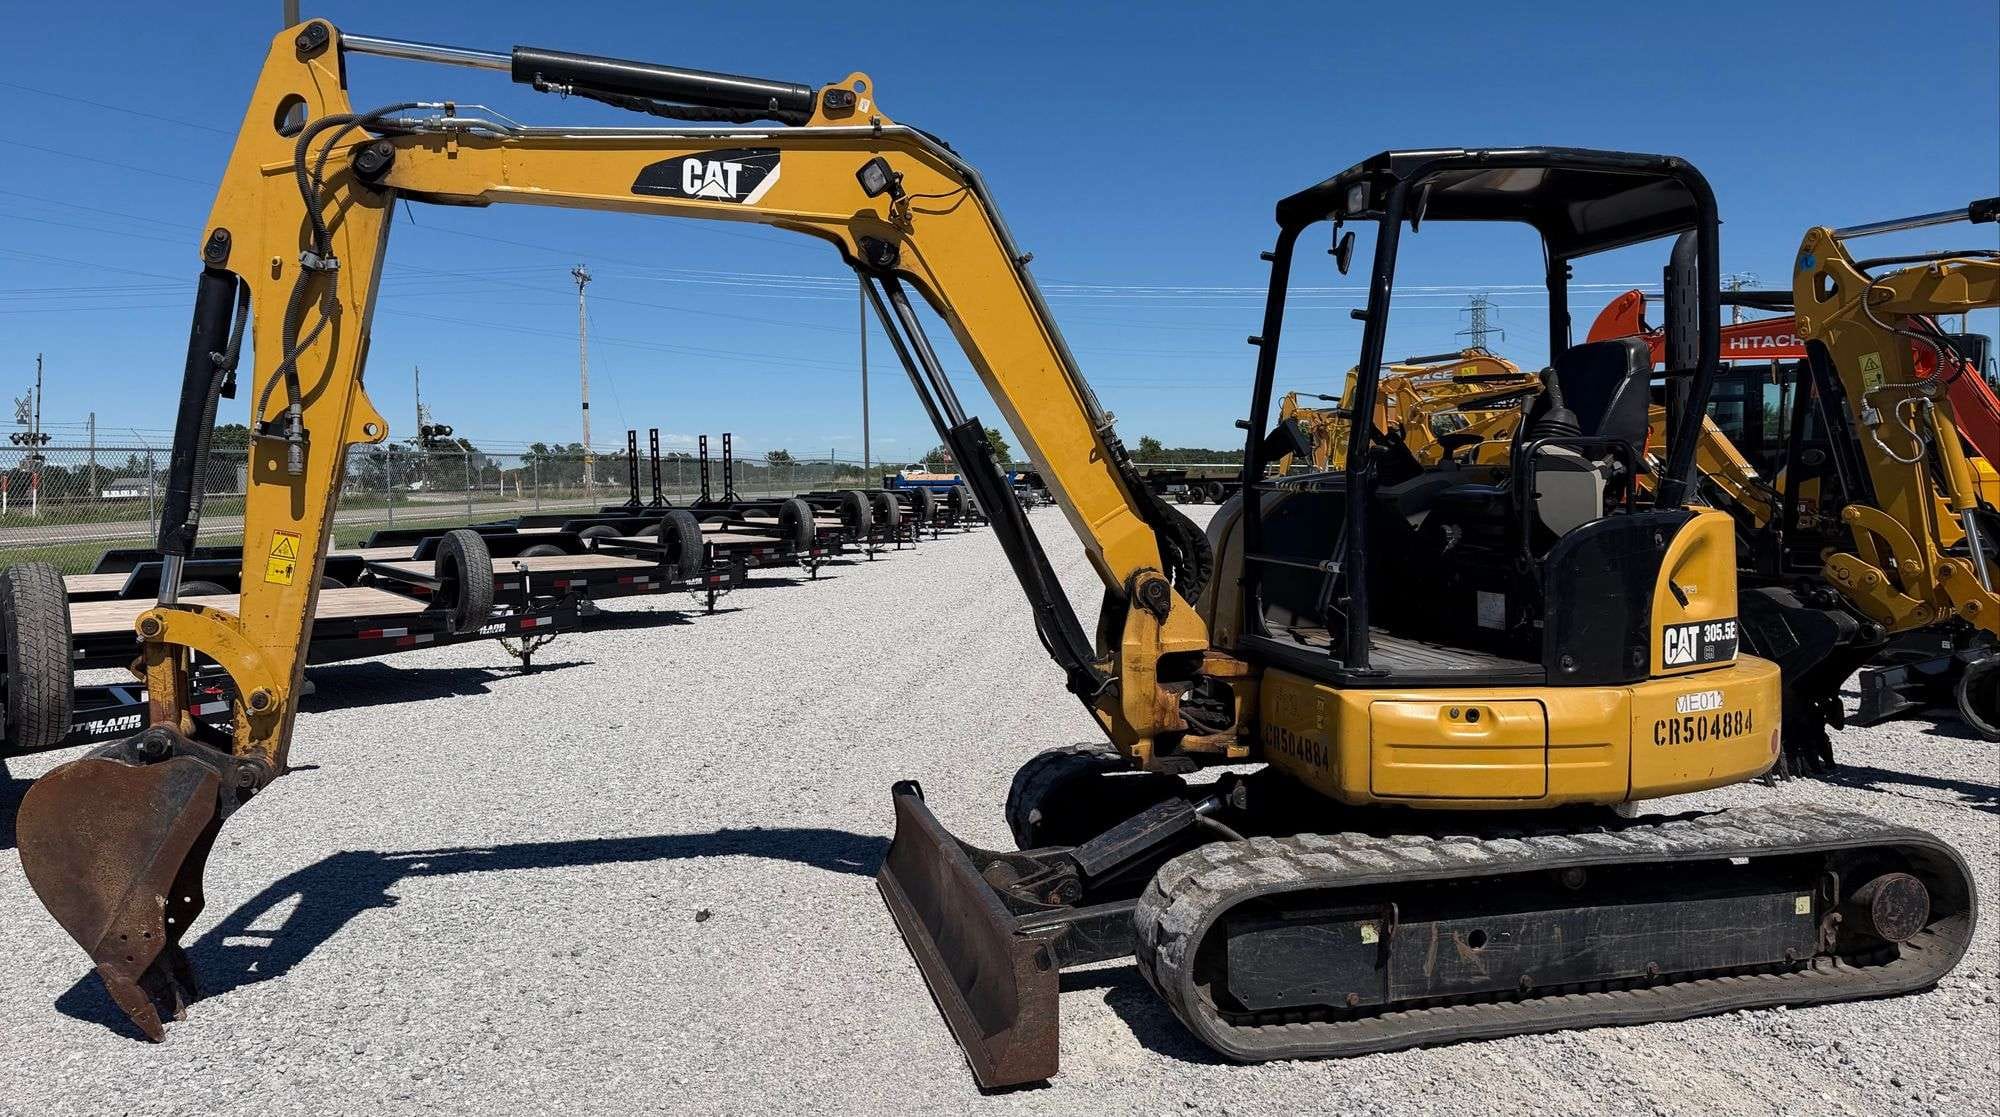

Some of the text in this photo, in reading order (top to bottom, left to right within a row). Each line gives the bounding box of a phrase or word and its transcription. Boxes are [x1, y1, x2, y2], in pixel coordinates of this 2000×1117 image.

[682, 158, 742, 198] CAT
[1730, 334, 1804, 349] HITACH
[1665, 626, 1699, 664] CAT
[90, 722, 141, 735] TRAILERS
[1654, 709, 1752, 746] CR504884
